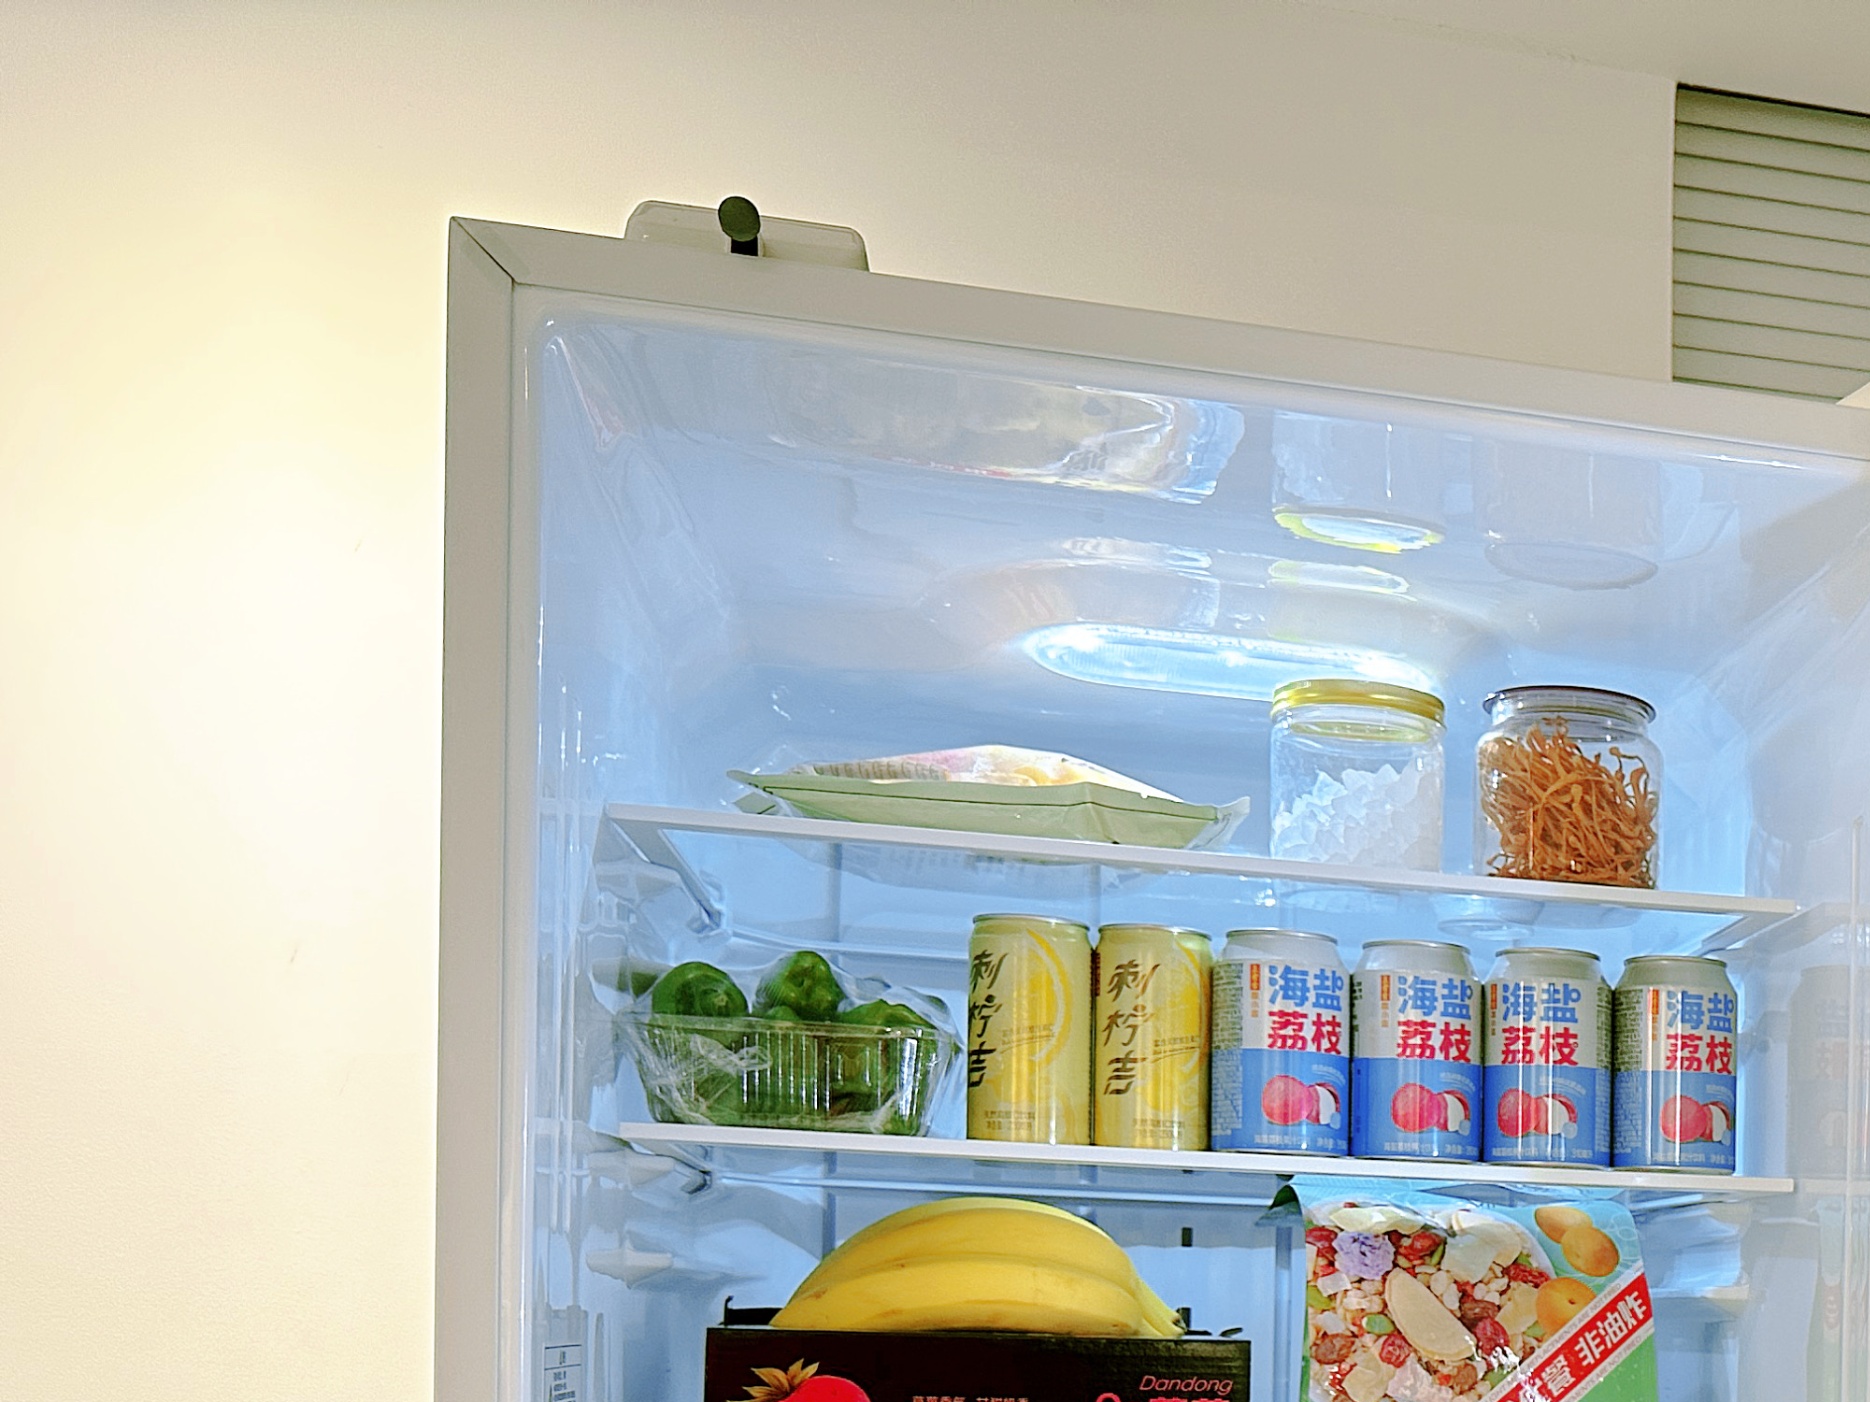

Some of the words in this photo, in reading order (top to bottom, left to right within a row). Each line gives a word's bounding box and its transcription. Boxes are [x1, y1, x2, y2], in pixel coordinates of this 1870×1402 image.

[1268, 964, 1344, 1012] 海盐
[1397, 975, 1473, 1020] 海盐
[1502, 982, 1581, 1023] 海盐
[1102, 959, 1161, 1096] 刺柠吉
[1267, 1009, 1342, 1055] 荔枝
[1667, 990, 1735, 1033] 海盐
[1396, 1018, 1472, 1063] 荔枝
[1501, 1025, 1579, 1066] 荔枝
[1666, 1032, 1733, 1074] 荔枝
[1574, 1291, 1647, 1368] 非油炸
[1138, 1375, 1234, 1396] Dandong
